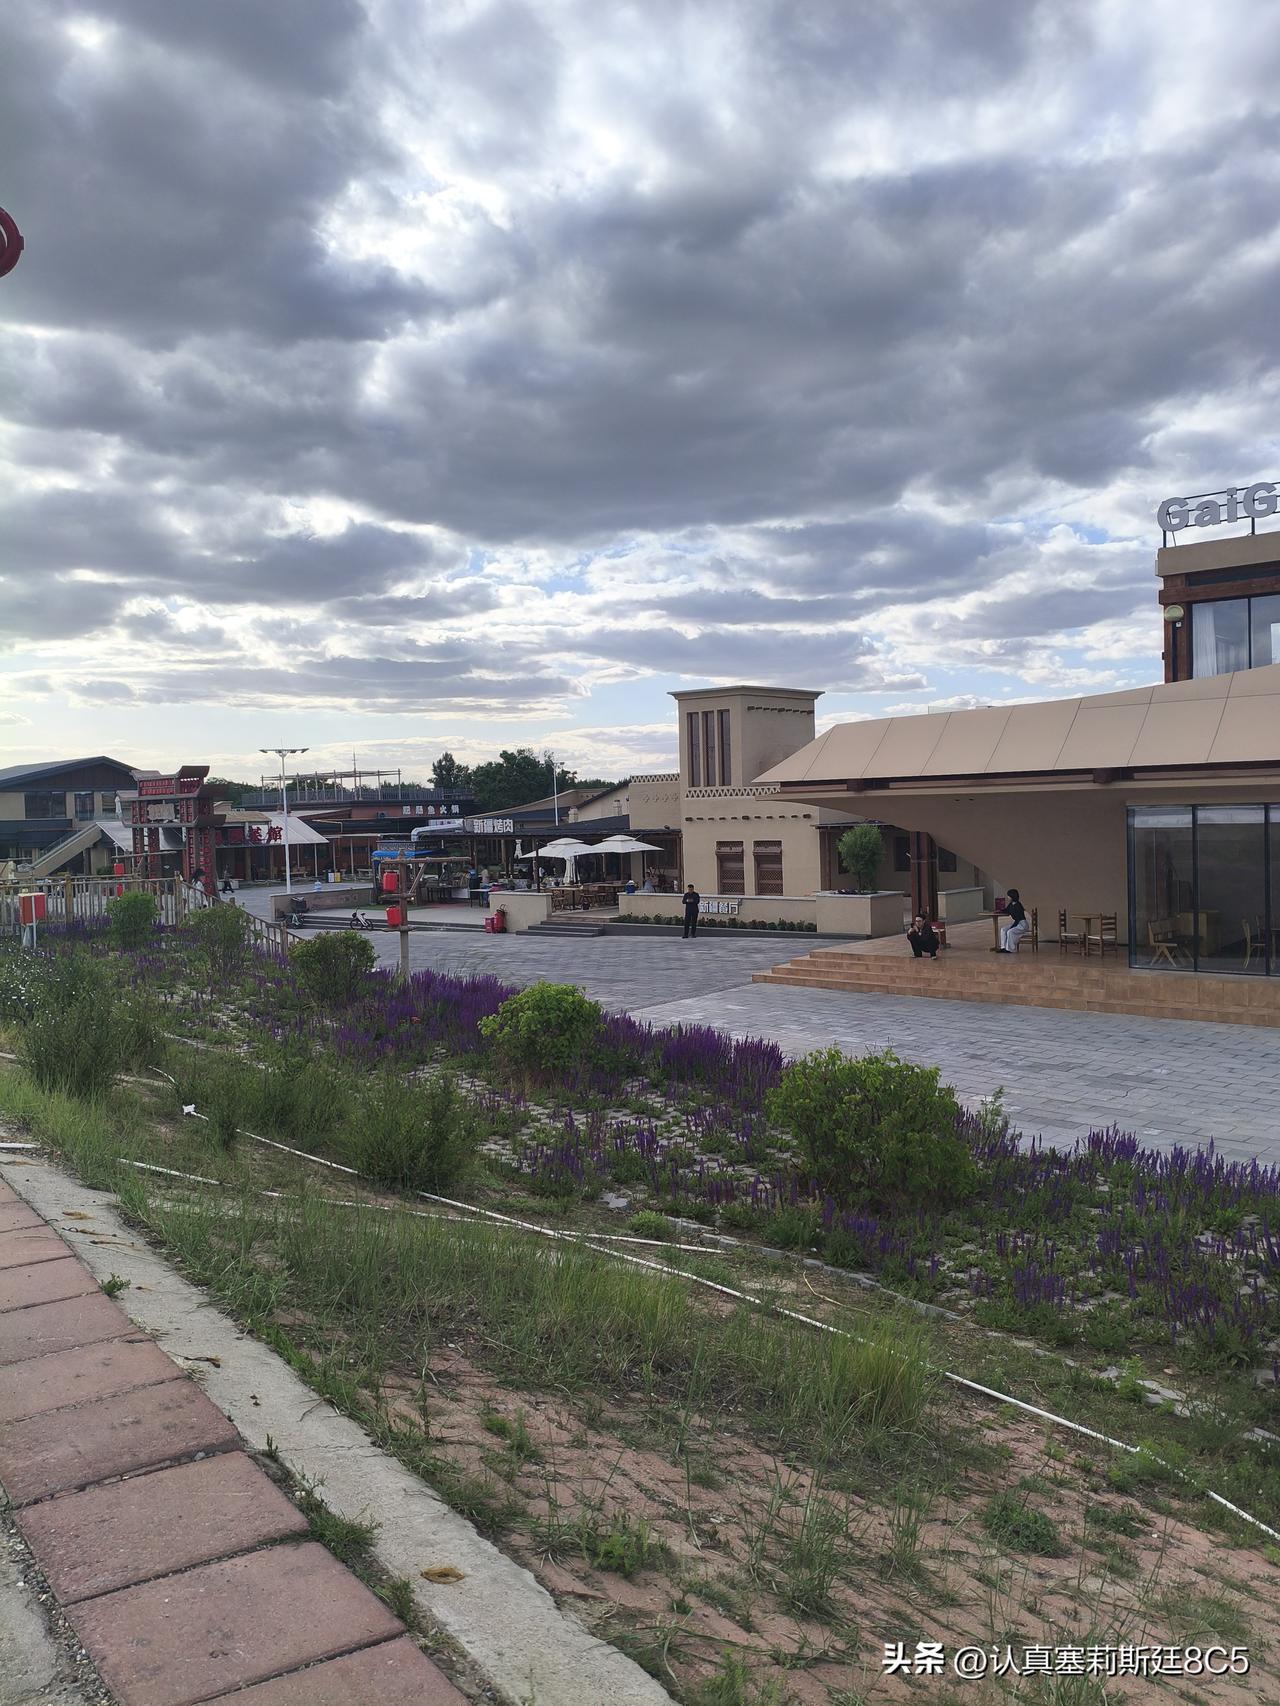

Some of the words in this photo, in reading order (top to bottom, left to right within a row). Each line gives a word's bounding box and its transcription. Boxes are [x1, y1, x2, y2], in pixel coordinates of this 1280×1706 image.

[1157, 482, 1278, 532] GaiG
[473, 819, 514, 833] 新疆烤肉
